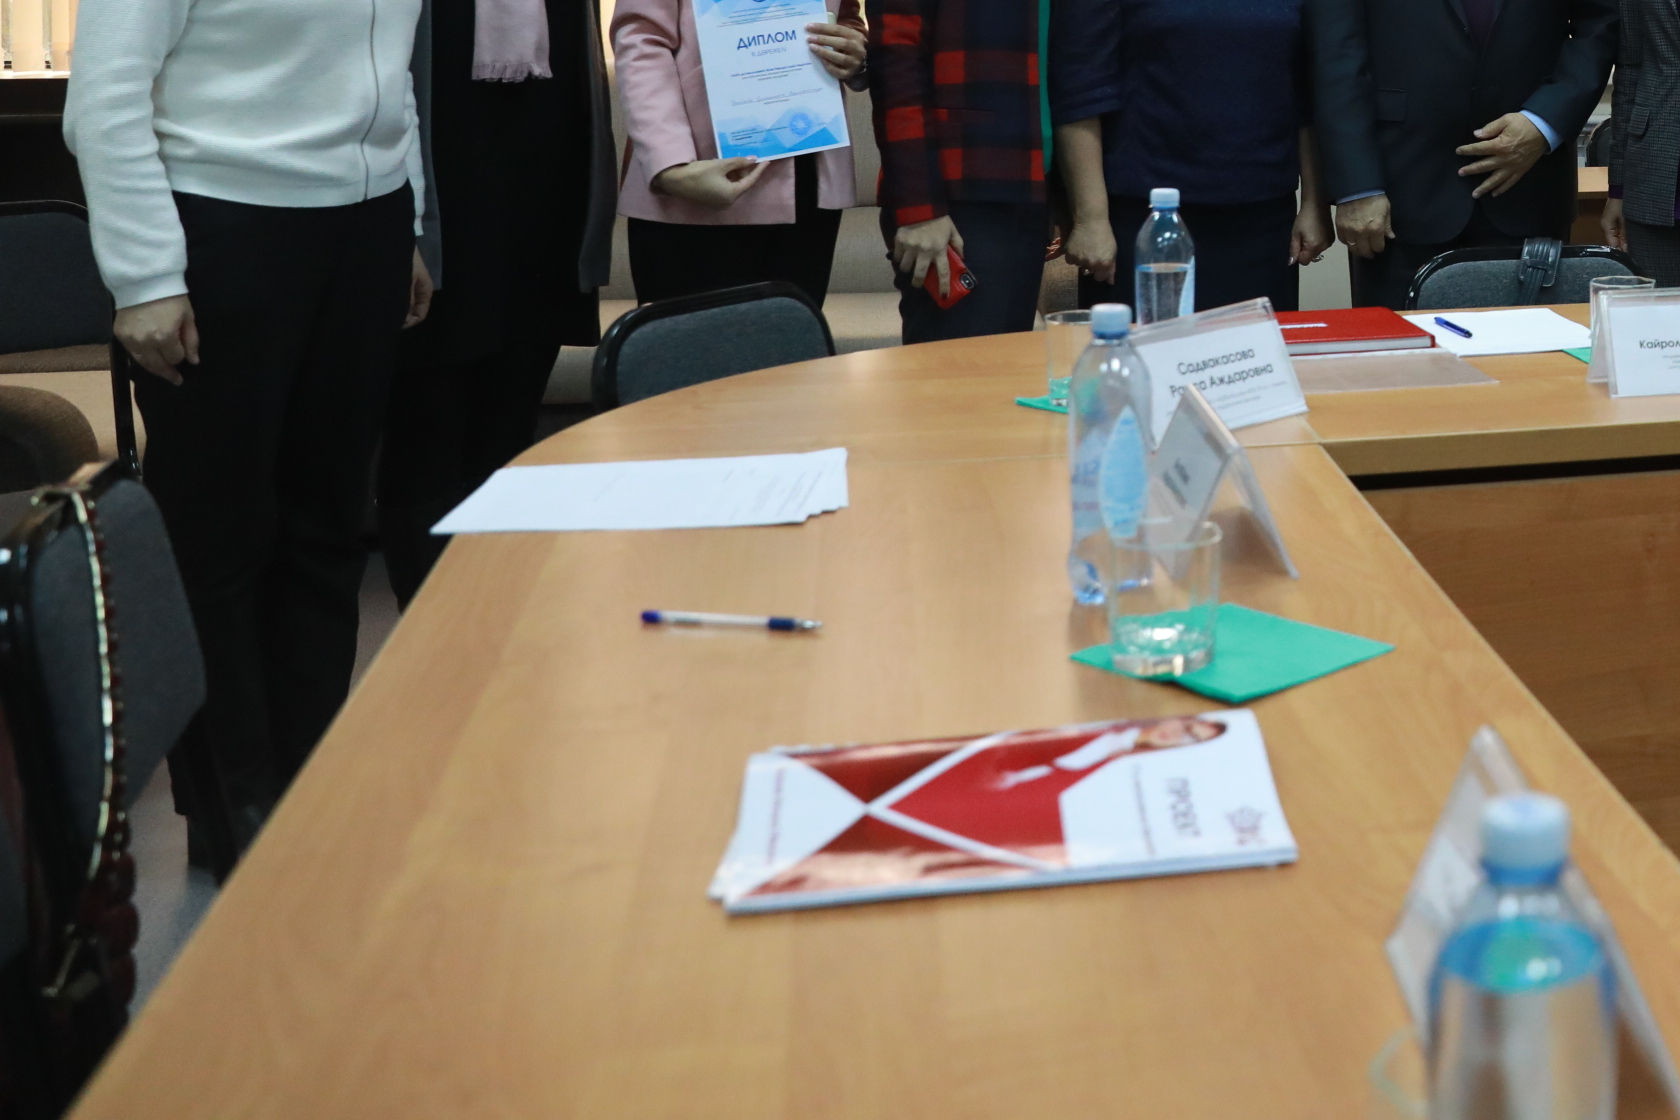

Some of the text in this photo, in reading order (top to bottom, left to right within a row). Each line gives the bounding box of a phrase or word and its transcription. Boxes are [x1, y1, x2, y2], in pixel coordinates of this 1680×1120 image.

[737, 29, 797, 50] ДИПЛОМ
[1177, 348, 1256, 375] Садвакасова
[1209, 363, 1274, 388] Аждаровна
